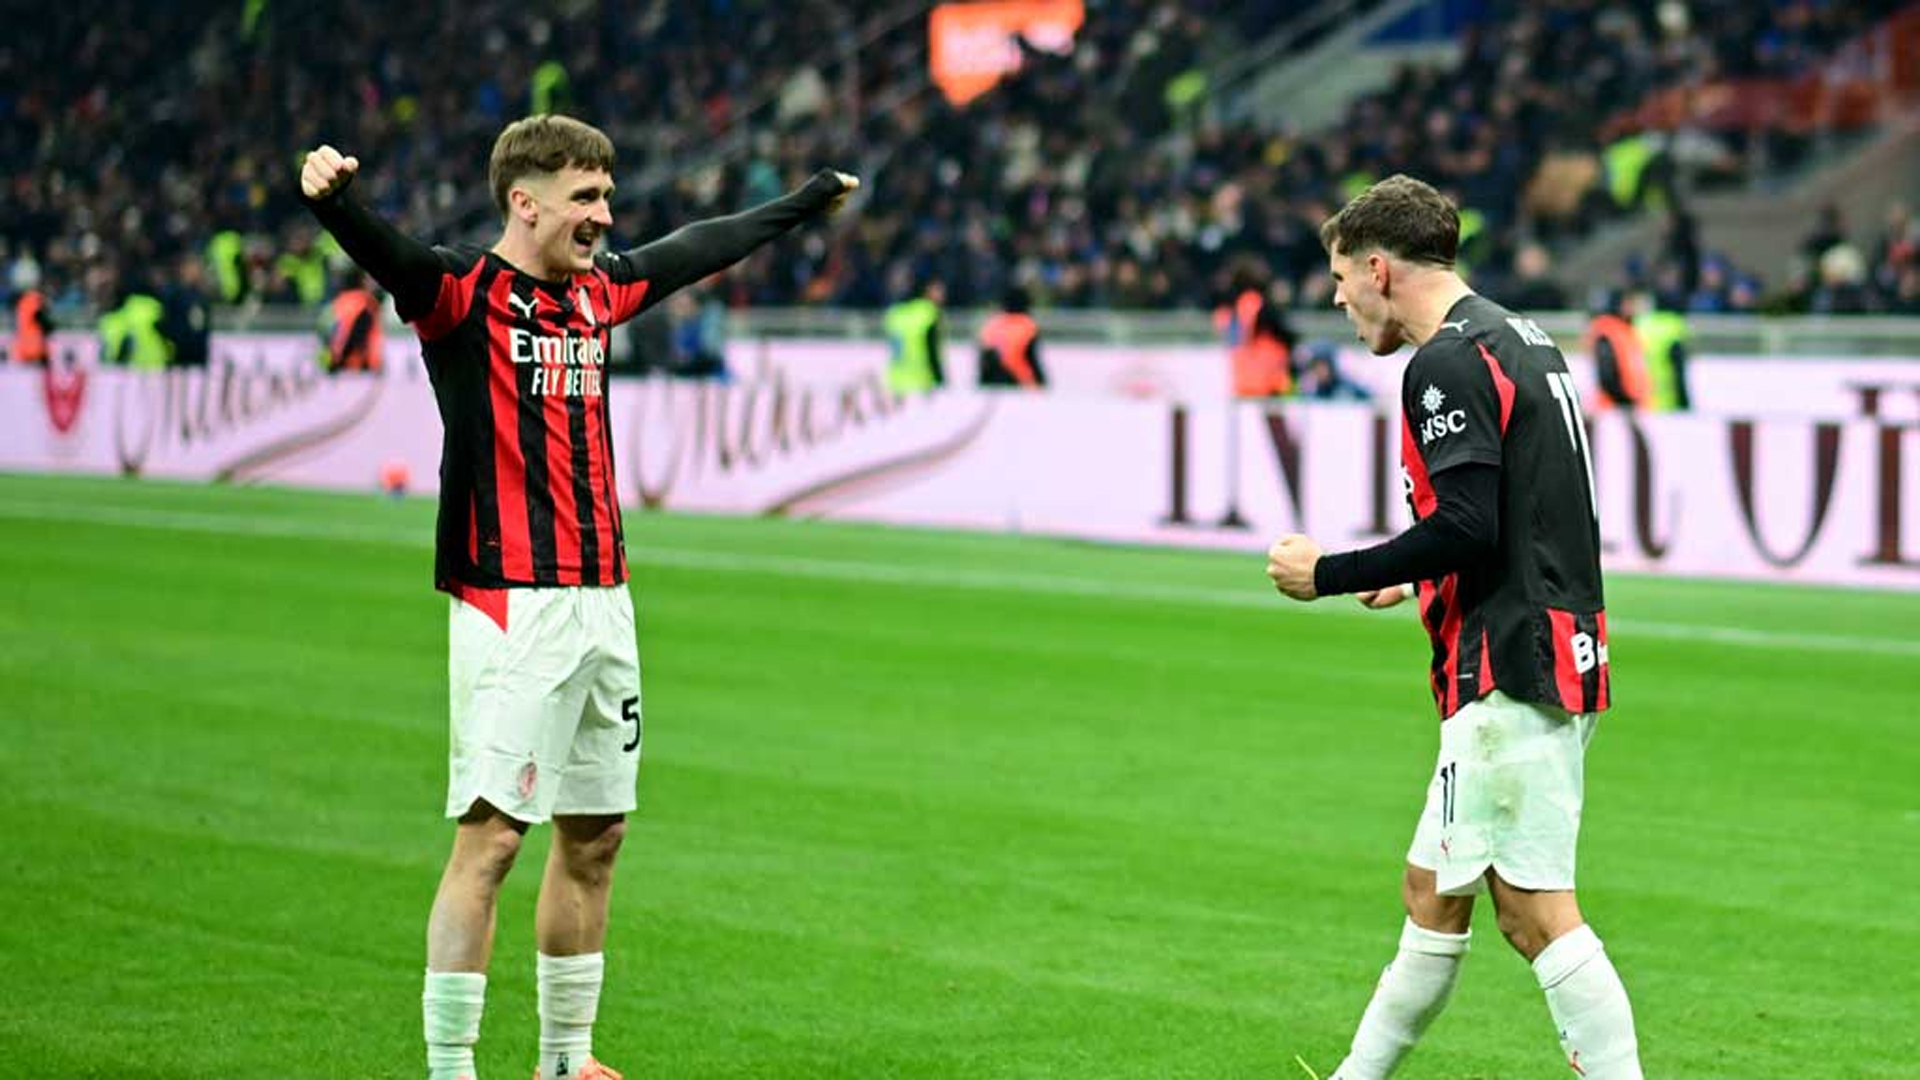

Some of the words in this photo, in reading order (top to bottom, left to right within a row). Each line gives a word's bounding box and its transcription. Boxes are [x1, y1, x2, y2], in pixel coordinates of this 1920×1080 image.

[531, 368, 562, 396] FLY
[1420, 410, 1467, 445] MSC
[1440, 762, 1456, 828] 11
